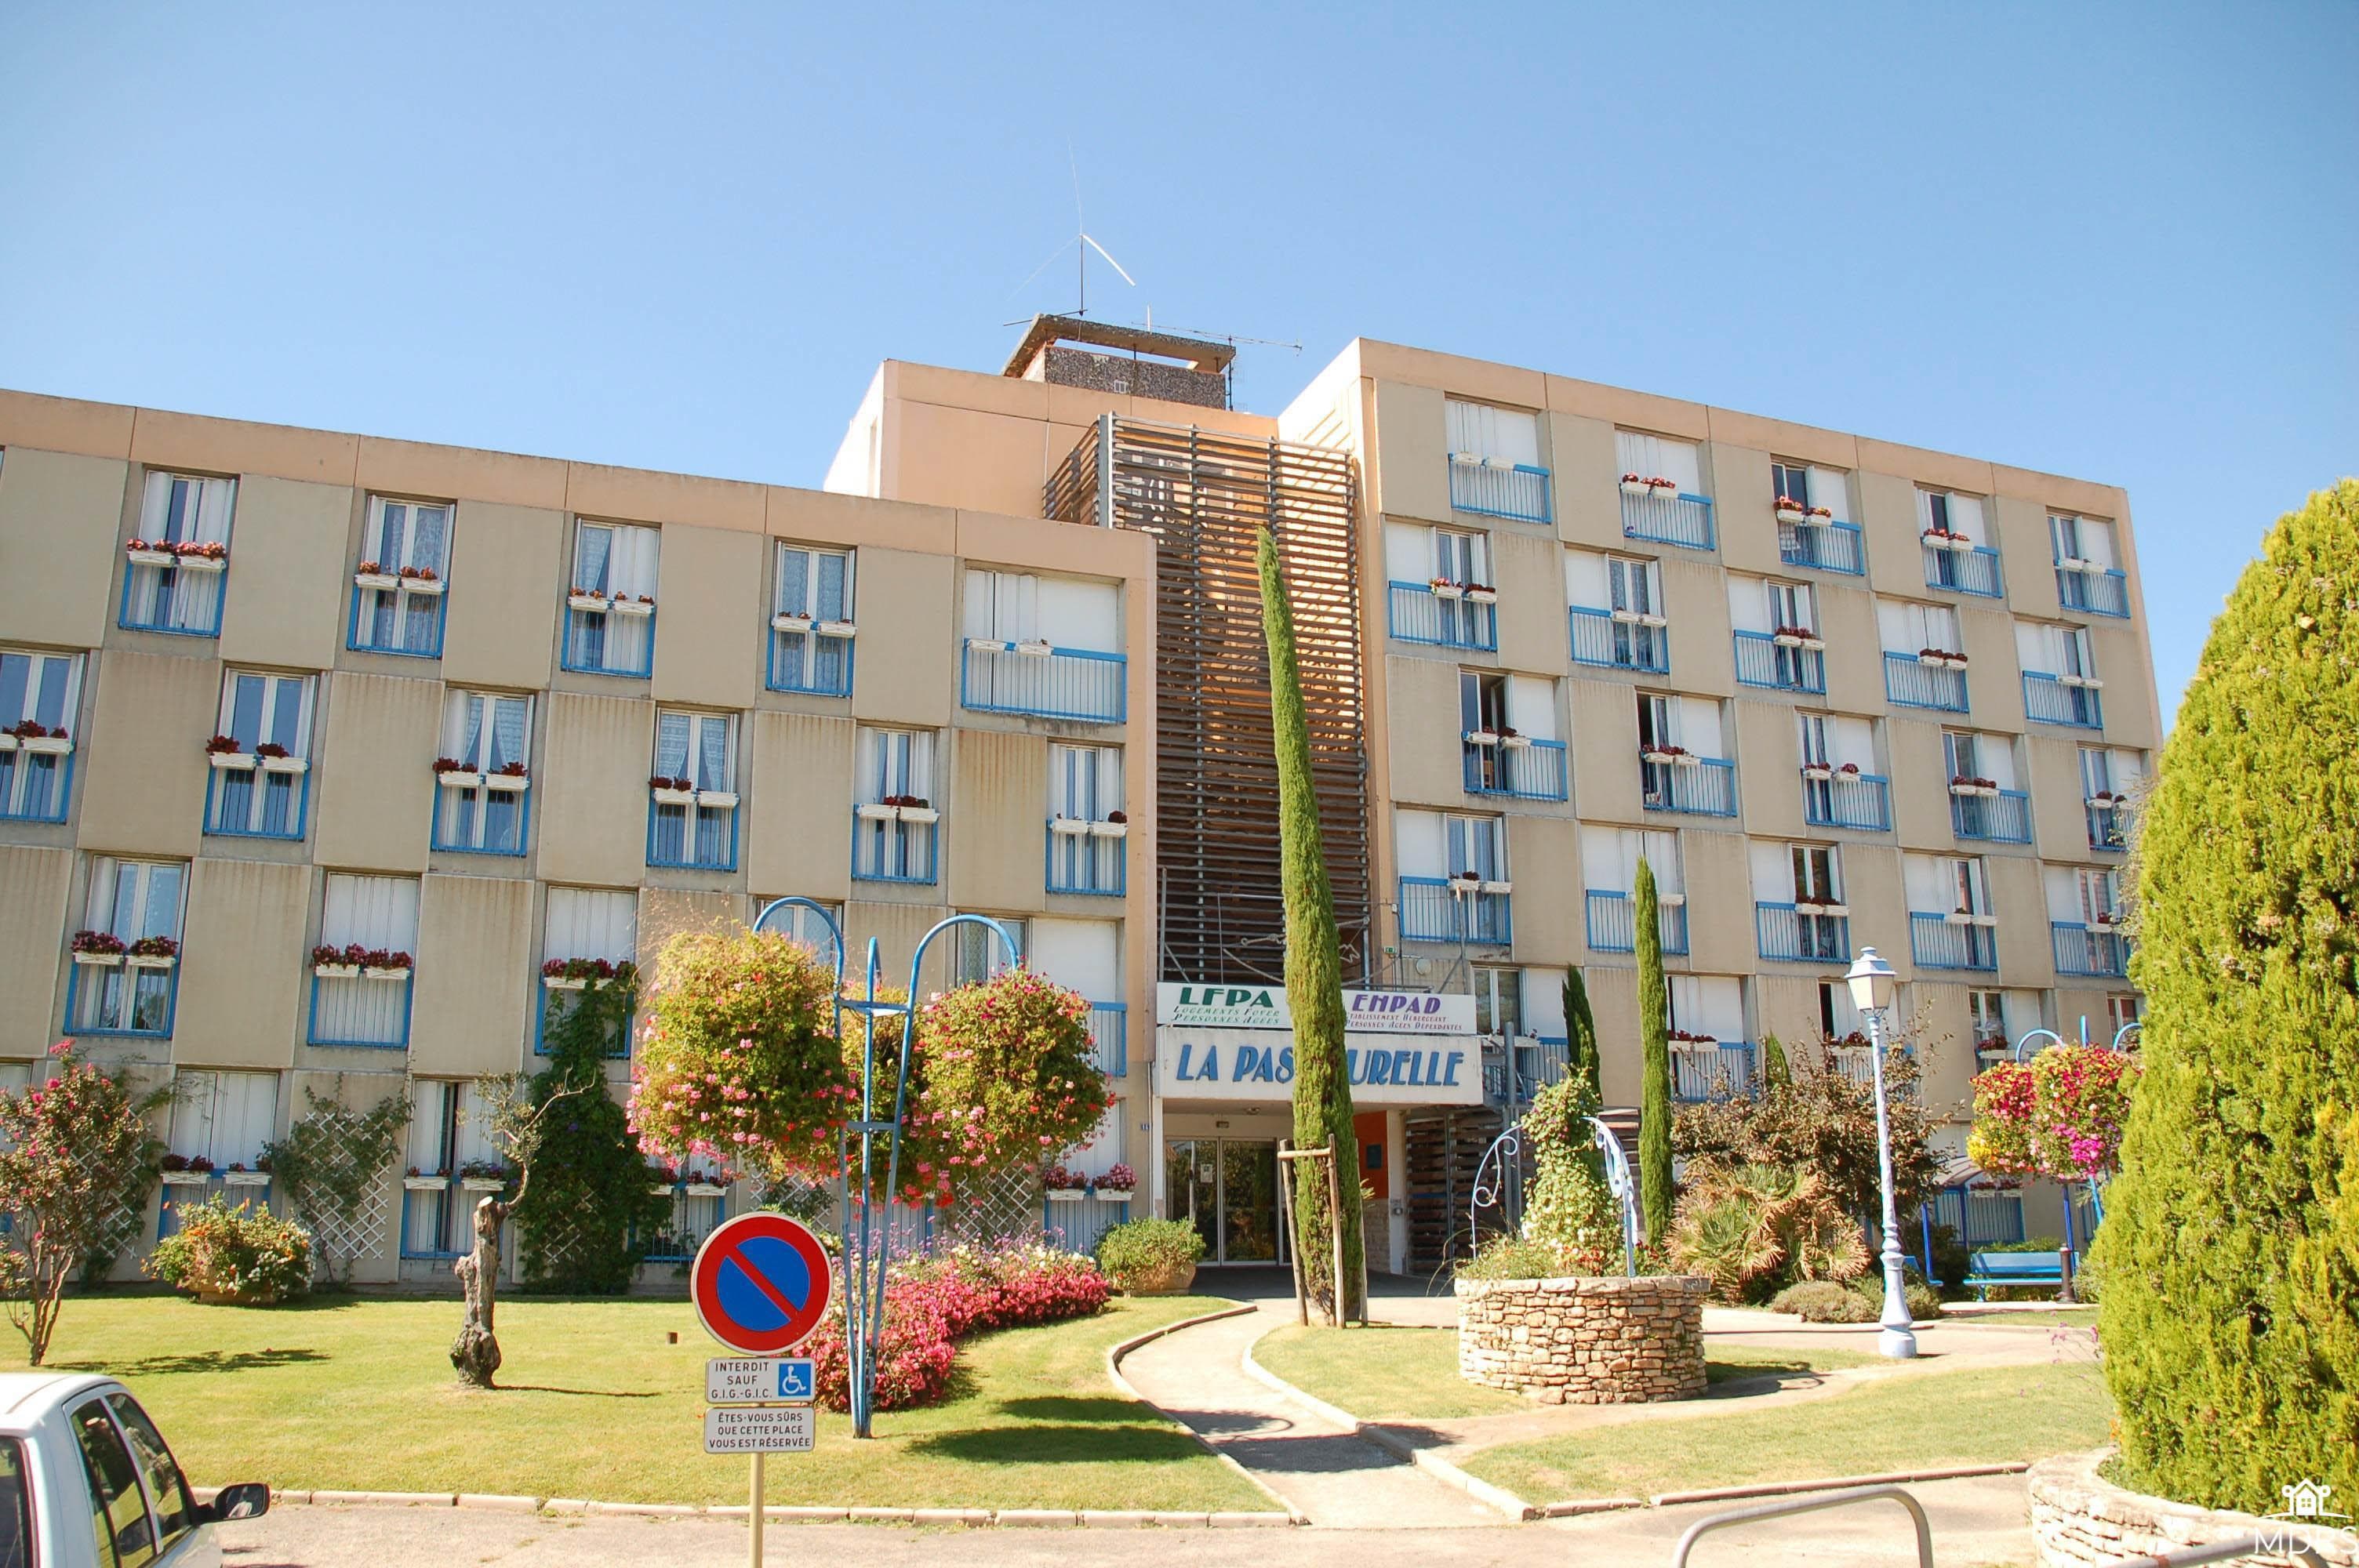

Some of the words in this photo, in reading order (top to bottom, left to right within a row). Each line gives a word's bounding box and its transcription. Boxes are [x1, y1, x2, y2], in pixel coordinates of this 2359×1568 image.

[1180, 987, 1274, 1007] LFPA
[1352, 994, 1441, 1014] EHPAD
[1173, 1006, 1240, 1015] LOGEMENTS
[1173, 1013, 1241, 1023] PERSONNES
[1176, 1044, 1219, 1080] LA
[1232, 1045, 1464, 1087] PASURELLE
[715, 1362, 769, 1372] INTERDIT
[727, 1375, 758, 1385] SAUF
[718, 1412, 774, 1423] ÊTES-VOUS
[777, 1411, 803, 1422] SÛRS
[718, 1426, 737, 1436] QUE
[740, 1425, 769, 1435] CETTE
[772, 1425, 803, 1435] PLACE
[709, 1439, 736, 1448] VOUS
[738, 1438, 756, 1448] EST
[759, 1437, 810, 1447] RÉSERVÉE
